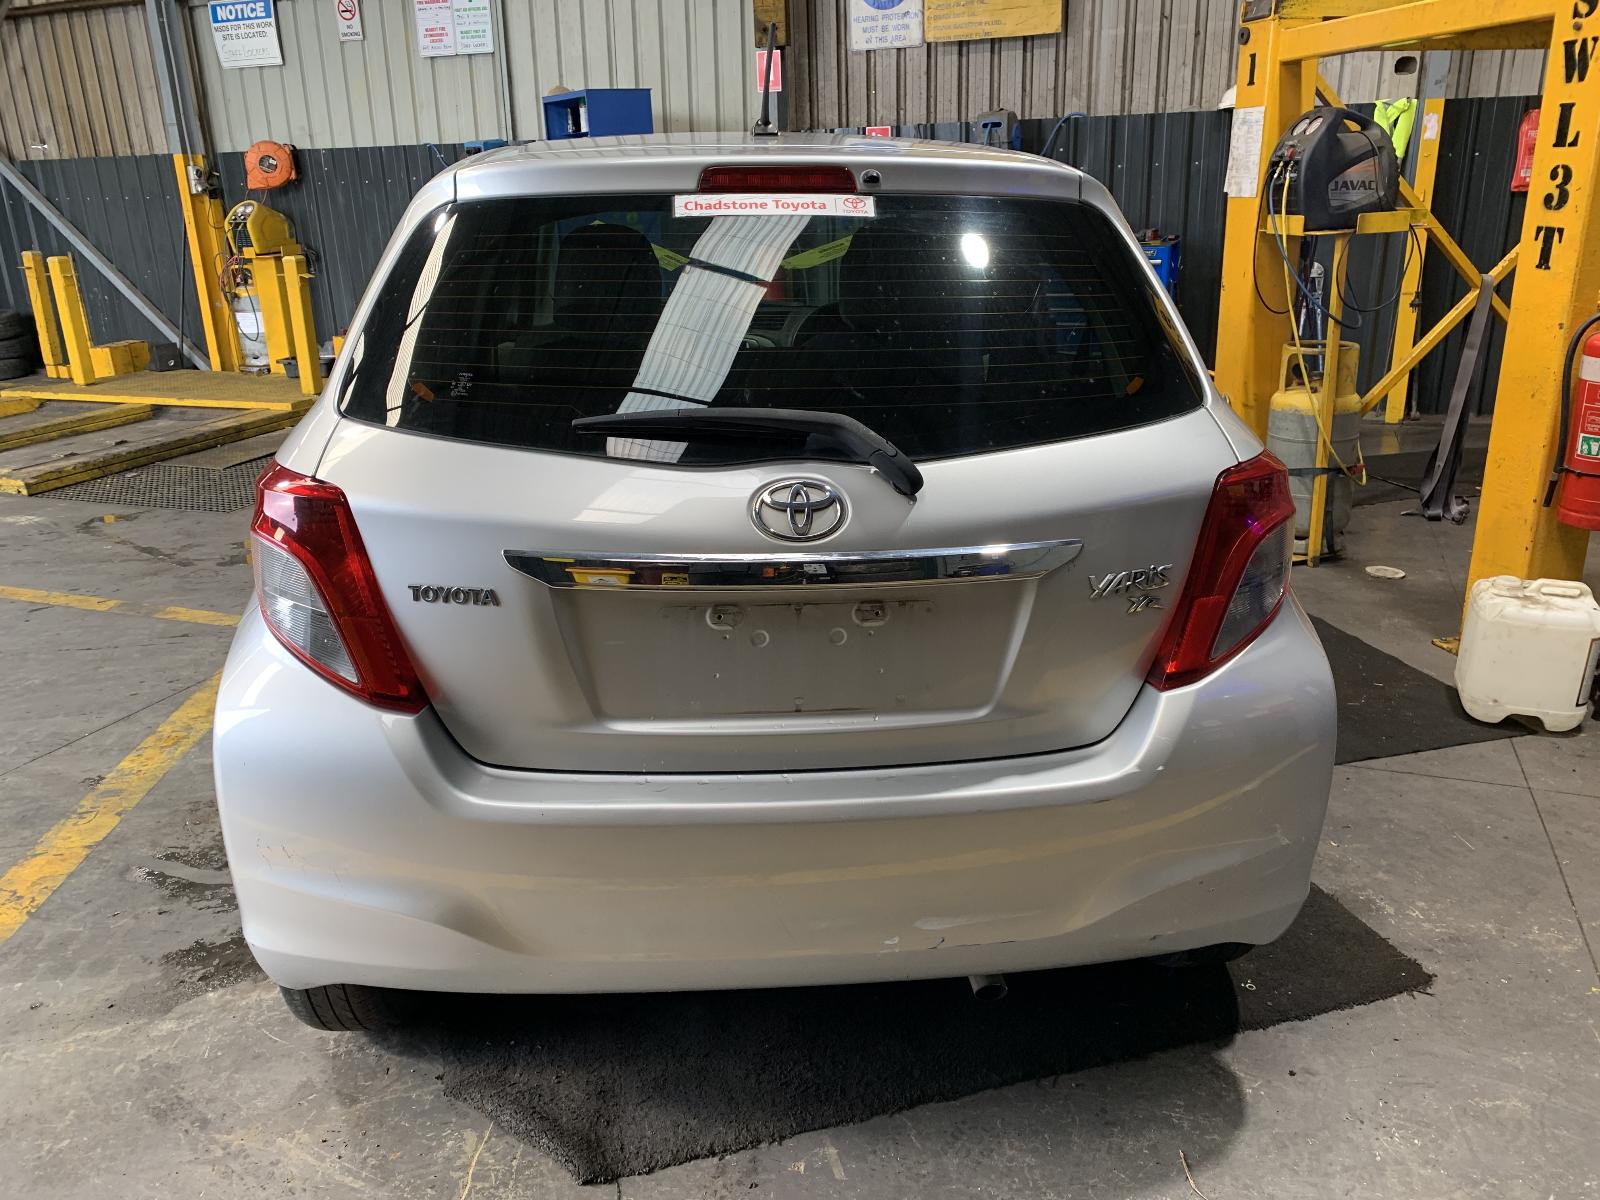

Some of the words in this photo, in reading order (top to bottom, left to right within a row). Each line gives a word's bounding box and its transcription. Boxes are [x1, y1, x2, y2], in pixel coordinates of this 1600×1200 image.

[216, 2, 266, 20] NOTICE
[853, 15, 880, 23] HEARING
[242, 22, 255, 30] THIS
[256, 21, 273, 29] WORK
[862, 25, 879, 33] MUST
[881, 25, 889, 33] BE
[892, 23, 910, 32] WORN
[222, 33, 235, 41] SITE
[865, 36, 872, 44] IN
[873, 36, 888, 44] THIS
[890, 35, 907, 43] AREA
[1330, 180, 1376, 192] JAVAC
[684, 200, 768, 211] Chadstone
[771, 200, 827, 212] Toyota
[408, 585, 501, 607] TOYOTA
